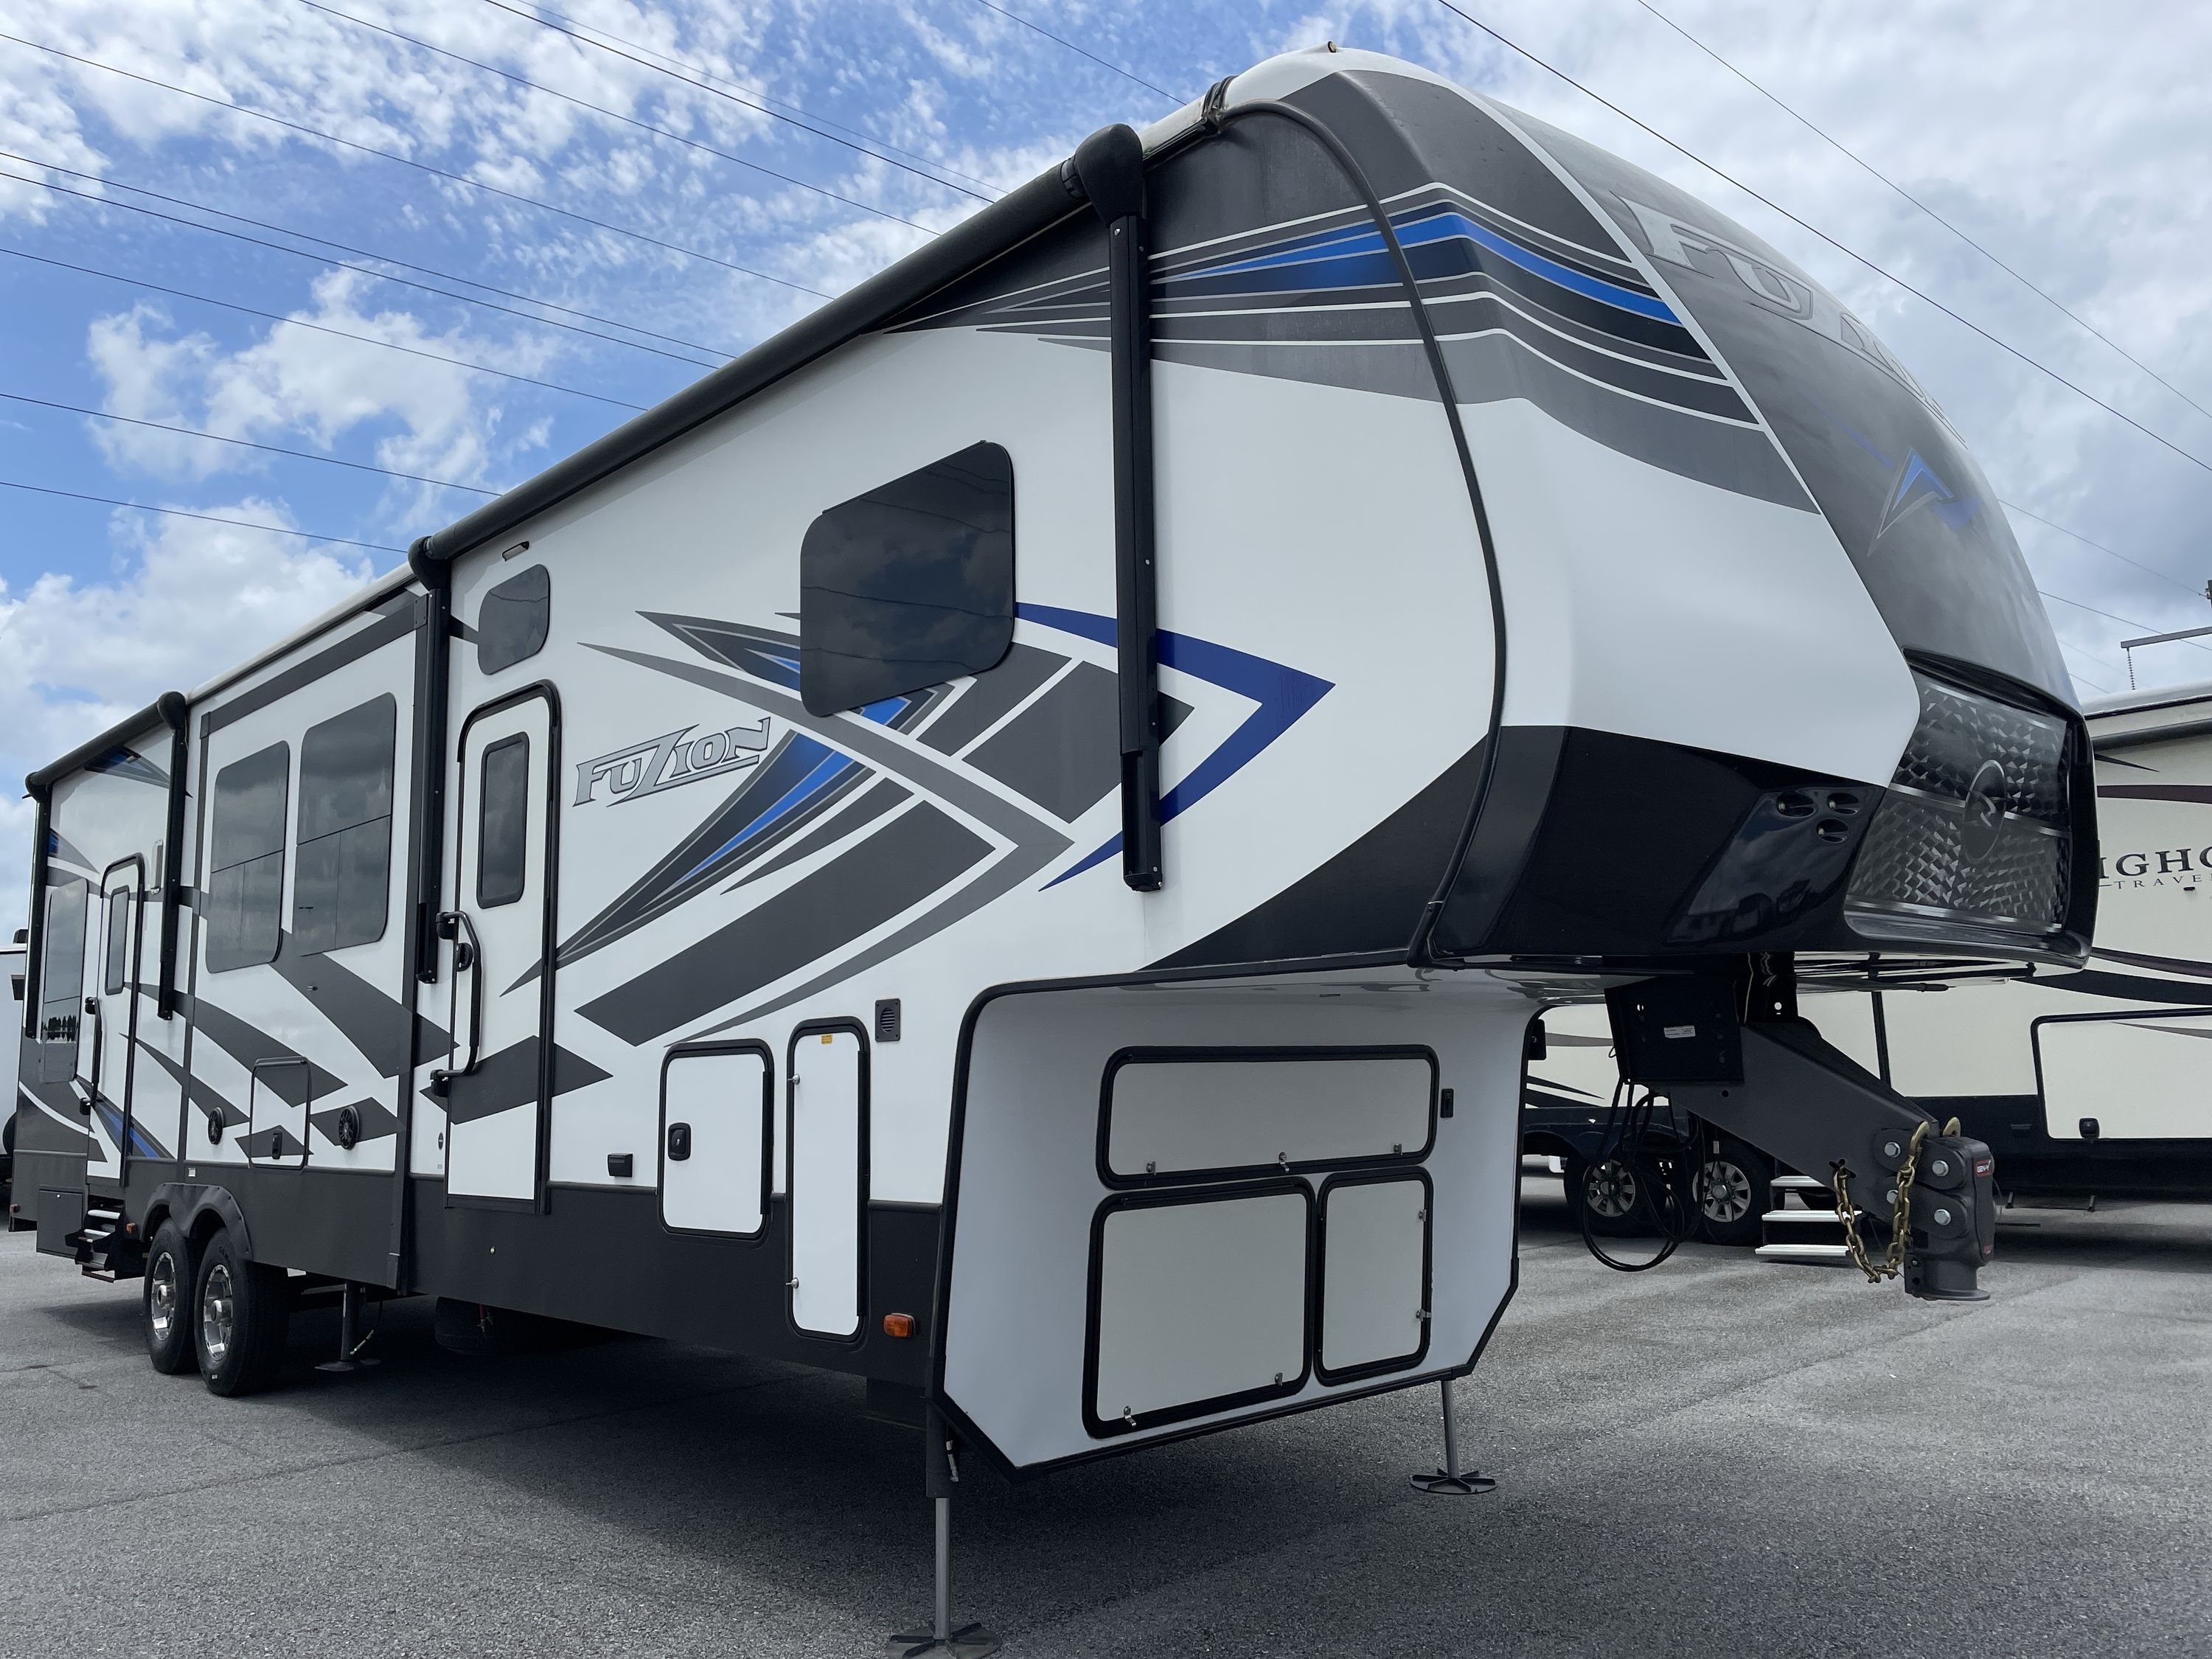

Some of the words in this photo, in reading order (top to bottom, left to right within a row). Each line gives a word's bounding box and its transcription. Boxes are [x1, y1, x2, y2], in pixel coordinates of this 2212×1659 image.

[1610, 190, 1968, 451] FUZ
[572, 717, 771, 807] FUZION
[2114, 873, 2212, 889] TRAVE
